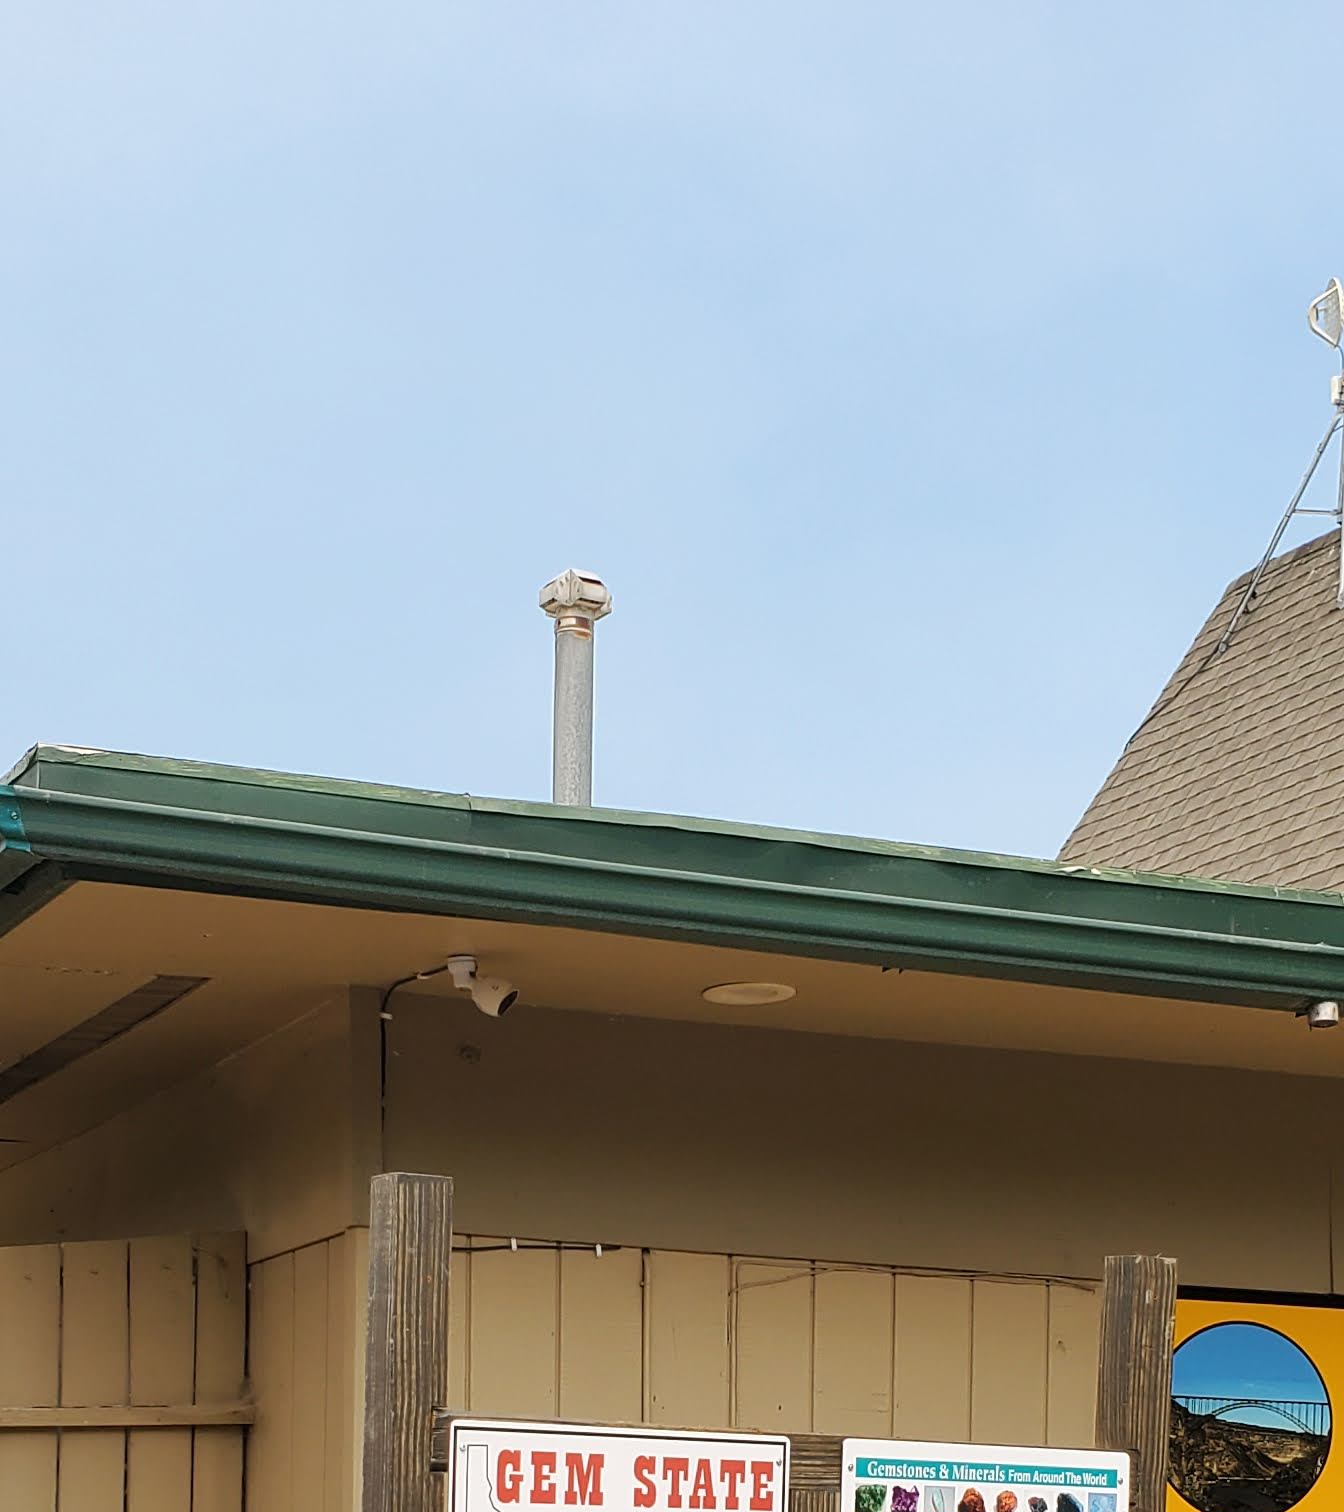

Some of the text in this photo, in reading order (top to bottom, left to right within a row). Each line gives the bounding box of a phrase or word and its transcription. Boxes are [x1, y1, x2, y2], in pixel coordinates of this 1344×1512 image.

[496, 1449, 774, 1511] GEM STATE
[867, 1461, 1107, 1485] Gemstones & Minerals From Around The World
